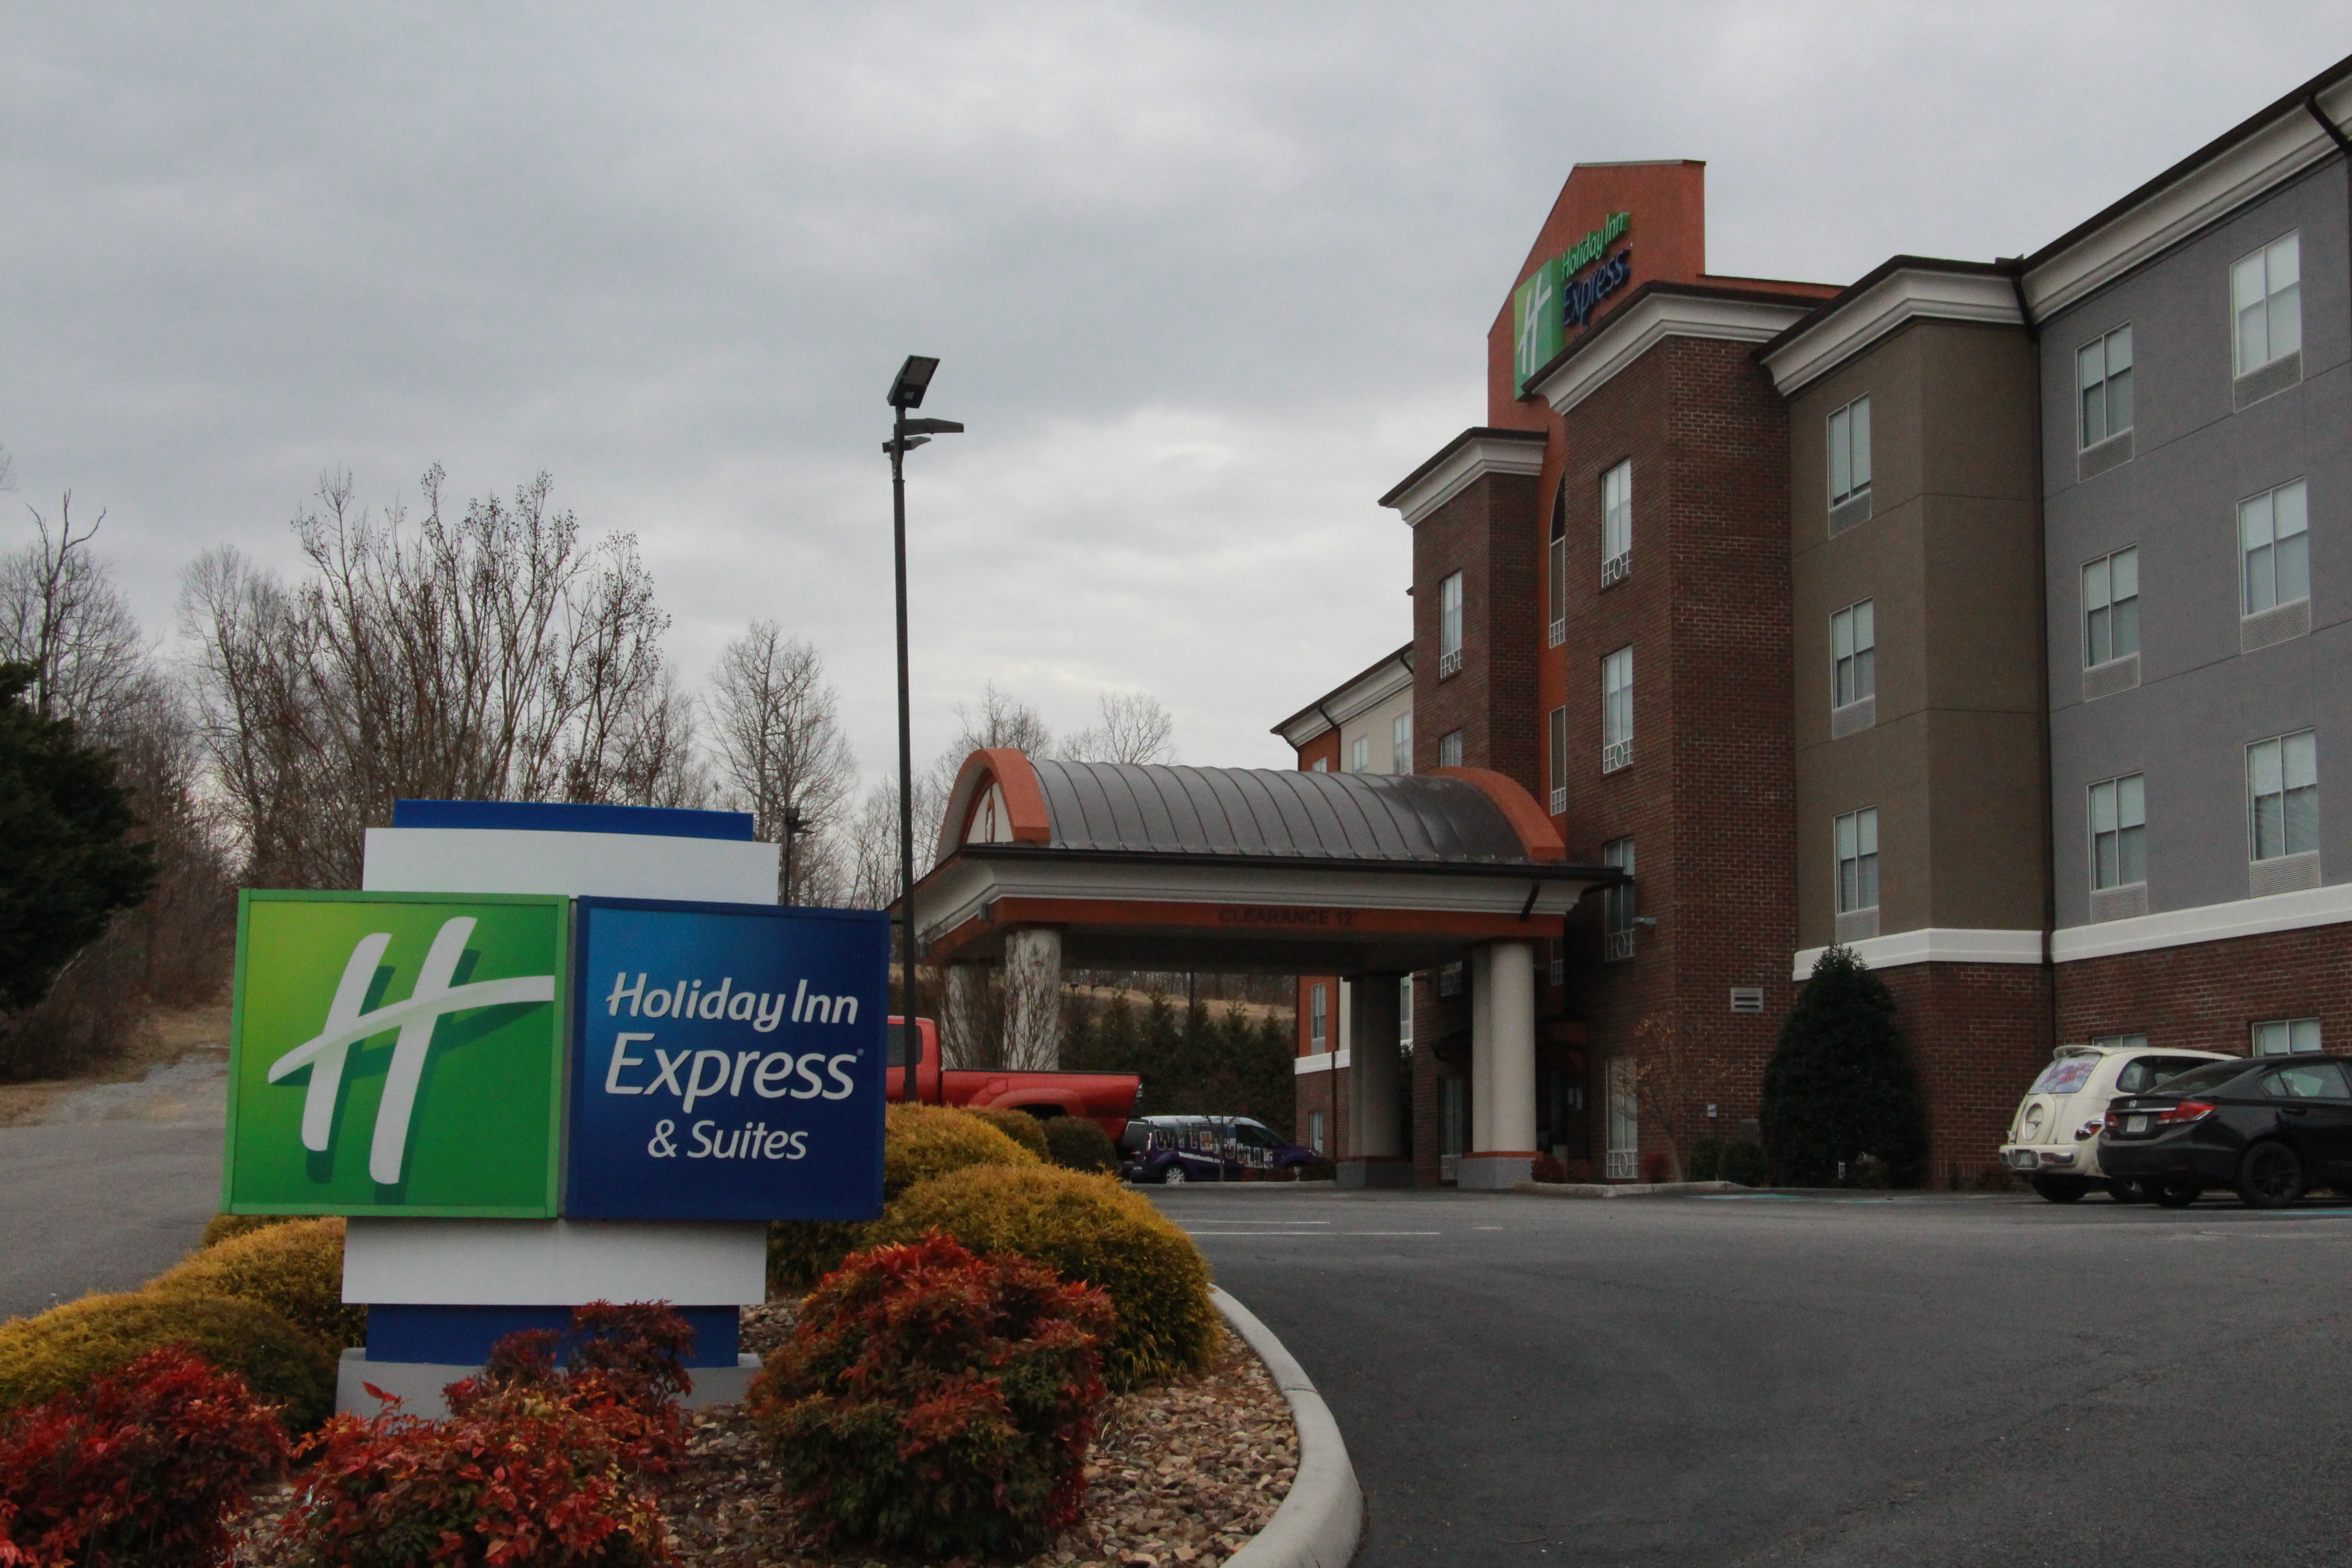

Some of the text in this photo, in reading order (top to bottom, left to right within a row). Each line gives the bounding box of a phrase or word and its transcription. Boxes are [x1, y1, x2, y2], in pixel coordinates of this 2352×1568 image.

[1562, 212, 1628, 281] Holiday Inn
[1563, 249, 1629, 326] Express
[1218, 907, 1330, 925] CLEARANCE
[606, 972, 858, 1032] Holiday Inn
[605, 1032, 857, 1114] Express
[647, 1119, 808, 1160] & Suites
